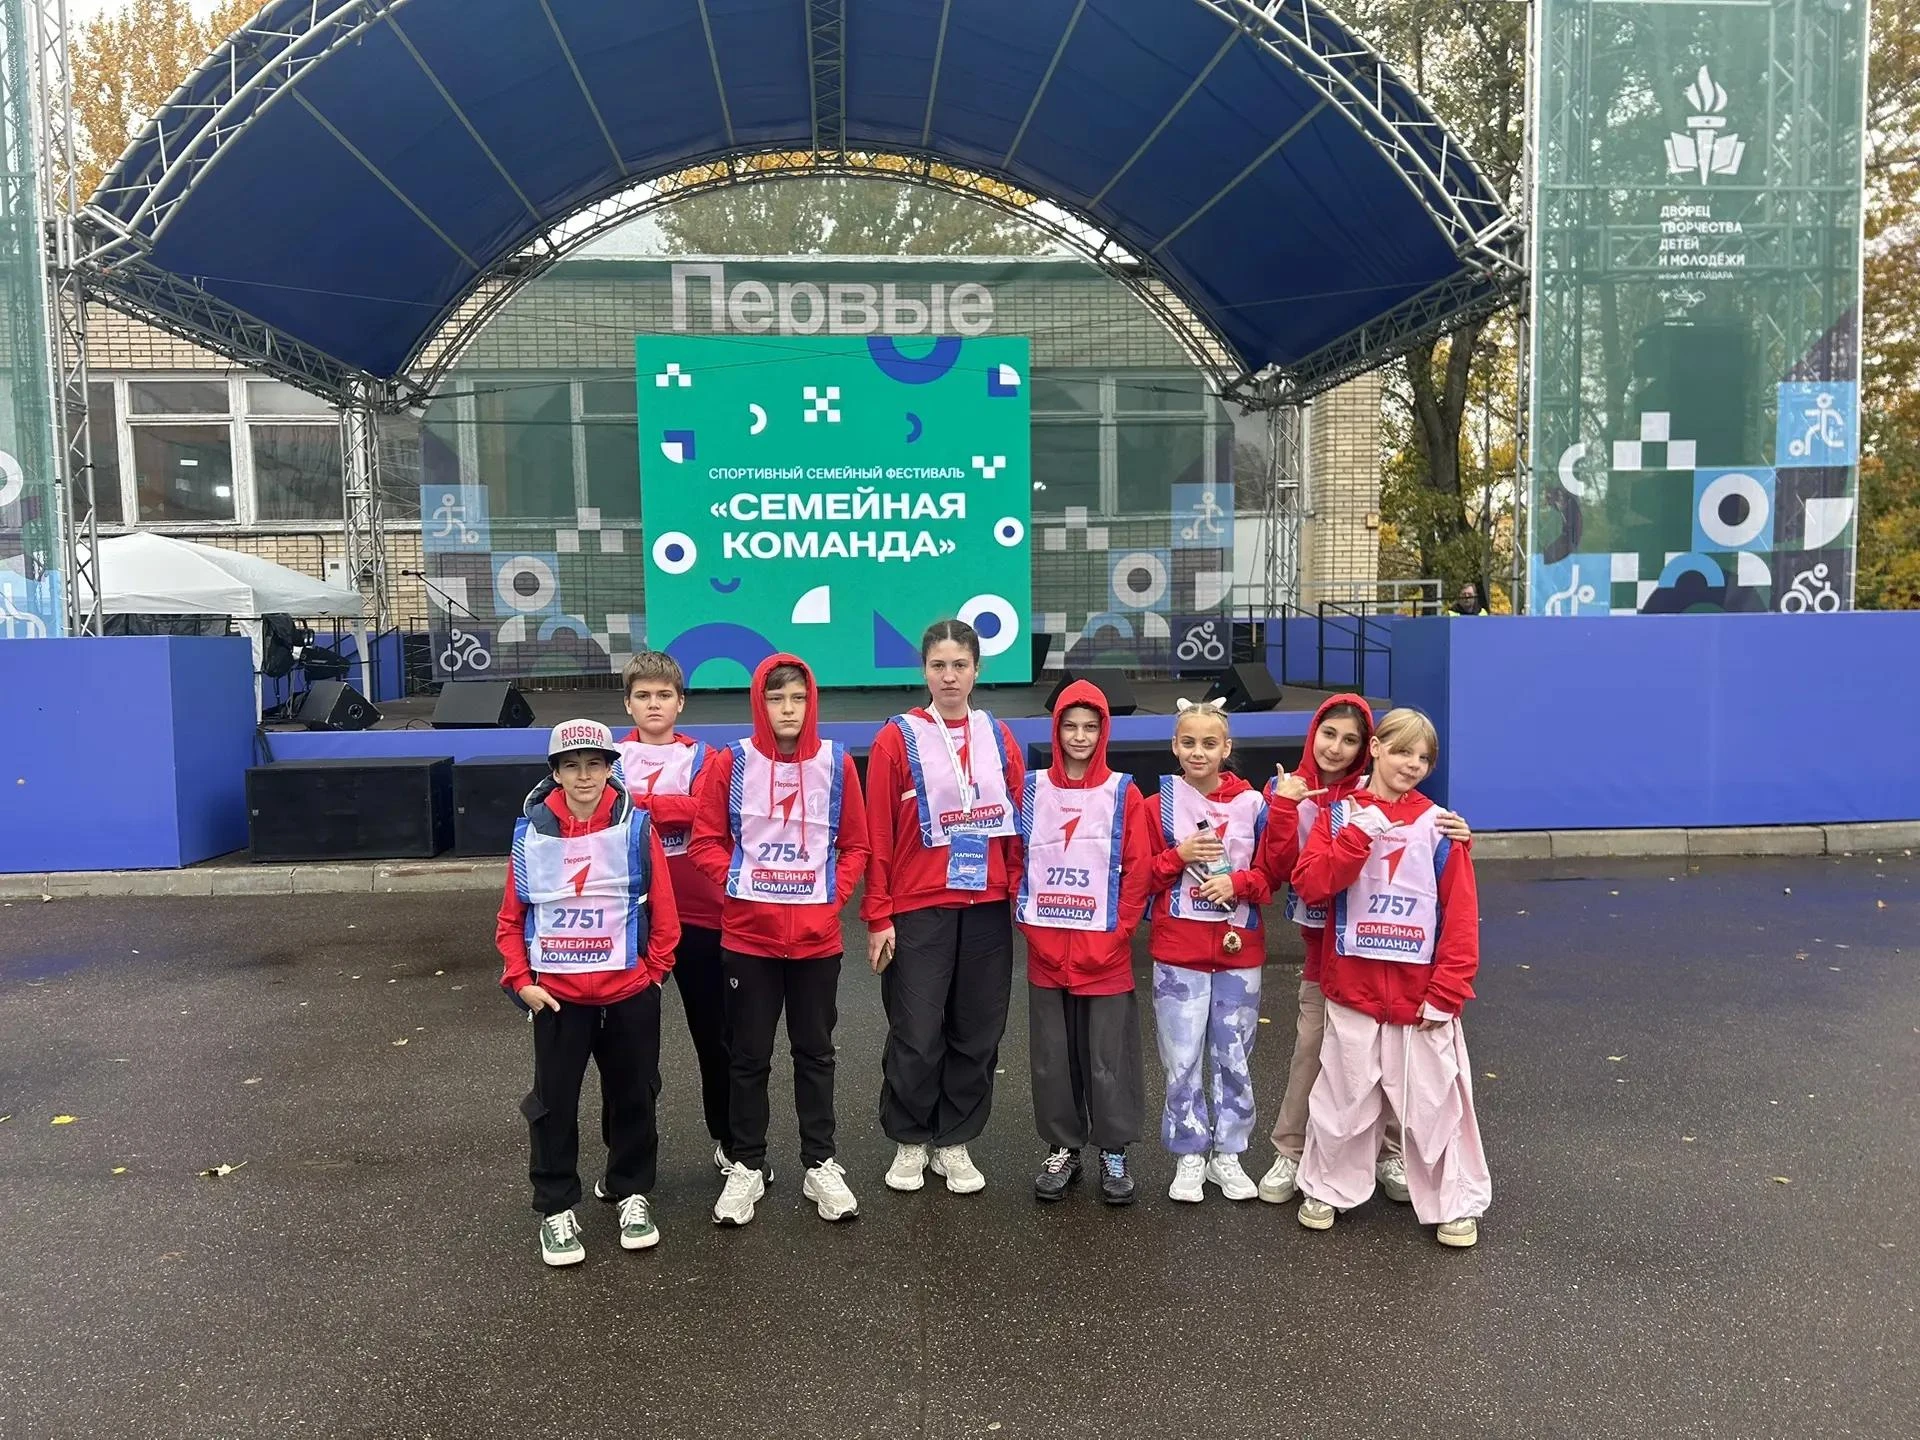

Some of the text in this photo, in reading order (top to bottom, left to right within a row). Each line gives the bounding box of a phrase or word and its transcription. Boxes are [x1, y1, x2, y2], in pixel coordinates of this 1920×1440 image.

[1660, 205, 1711, 218] ДВОРЕЦ
[1660, 221, 1743, 233] ТВОРЧЕСТВА
[1659, 236, 1700, 250] ДЕТЕЙ
[1659, 252, 1745, 267] И МОЛОДЁЖИ
[671, 263, 995, 336] Первые
[708, 466, 965, 480] СПОРТИВНЫЙ СЕМЕЙНЫЙ ФЕСТИВАЛЬ
[710, 486, 966, 521] «СЕМЕЙНАЯ
[723, 531, 956, 563] КОМАНДА»
[561, 726, 604, 742] RUSSIA
[562, 738, 604, 749] HANDBALL
[774, 781, 800, 790] Первые
[757, 842, 810, 863] 2754
[563, 855, 592, 865] Первые
[752, 871, 815, 881] СЕМЕЙНАЯ
[1046, 866, 1090, 888] 2753
[753, 880, 812, 894] КОМАНДА
[1038, 894, 1095, 908] СЕМЕЙНАЯ
[1368, 894, 1418, 917] 2757
[552, 908, 603, 929] 2751
[1038, 906, 1091, 919] КОМАНДА
[1357, 923, 1423, 939] СЕМЕЙНАЯ
[541, 938, 611, 949] СЕМЕЙНАЯ
[1357, 936, 1419, 951] КОМАНДА
[542, 951, 608, 963] КОМАНДА
